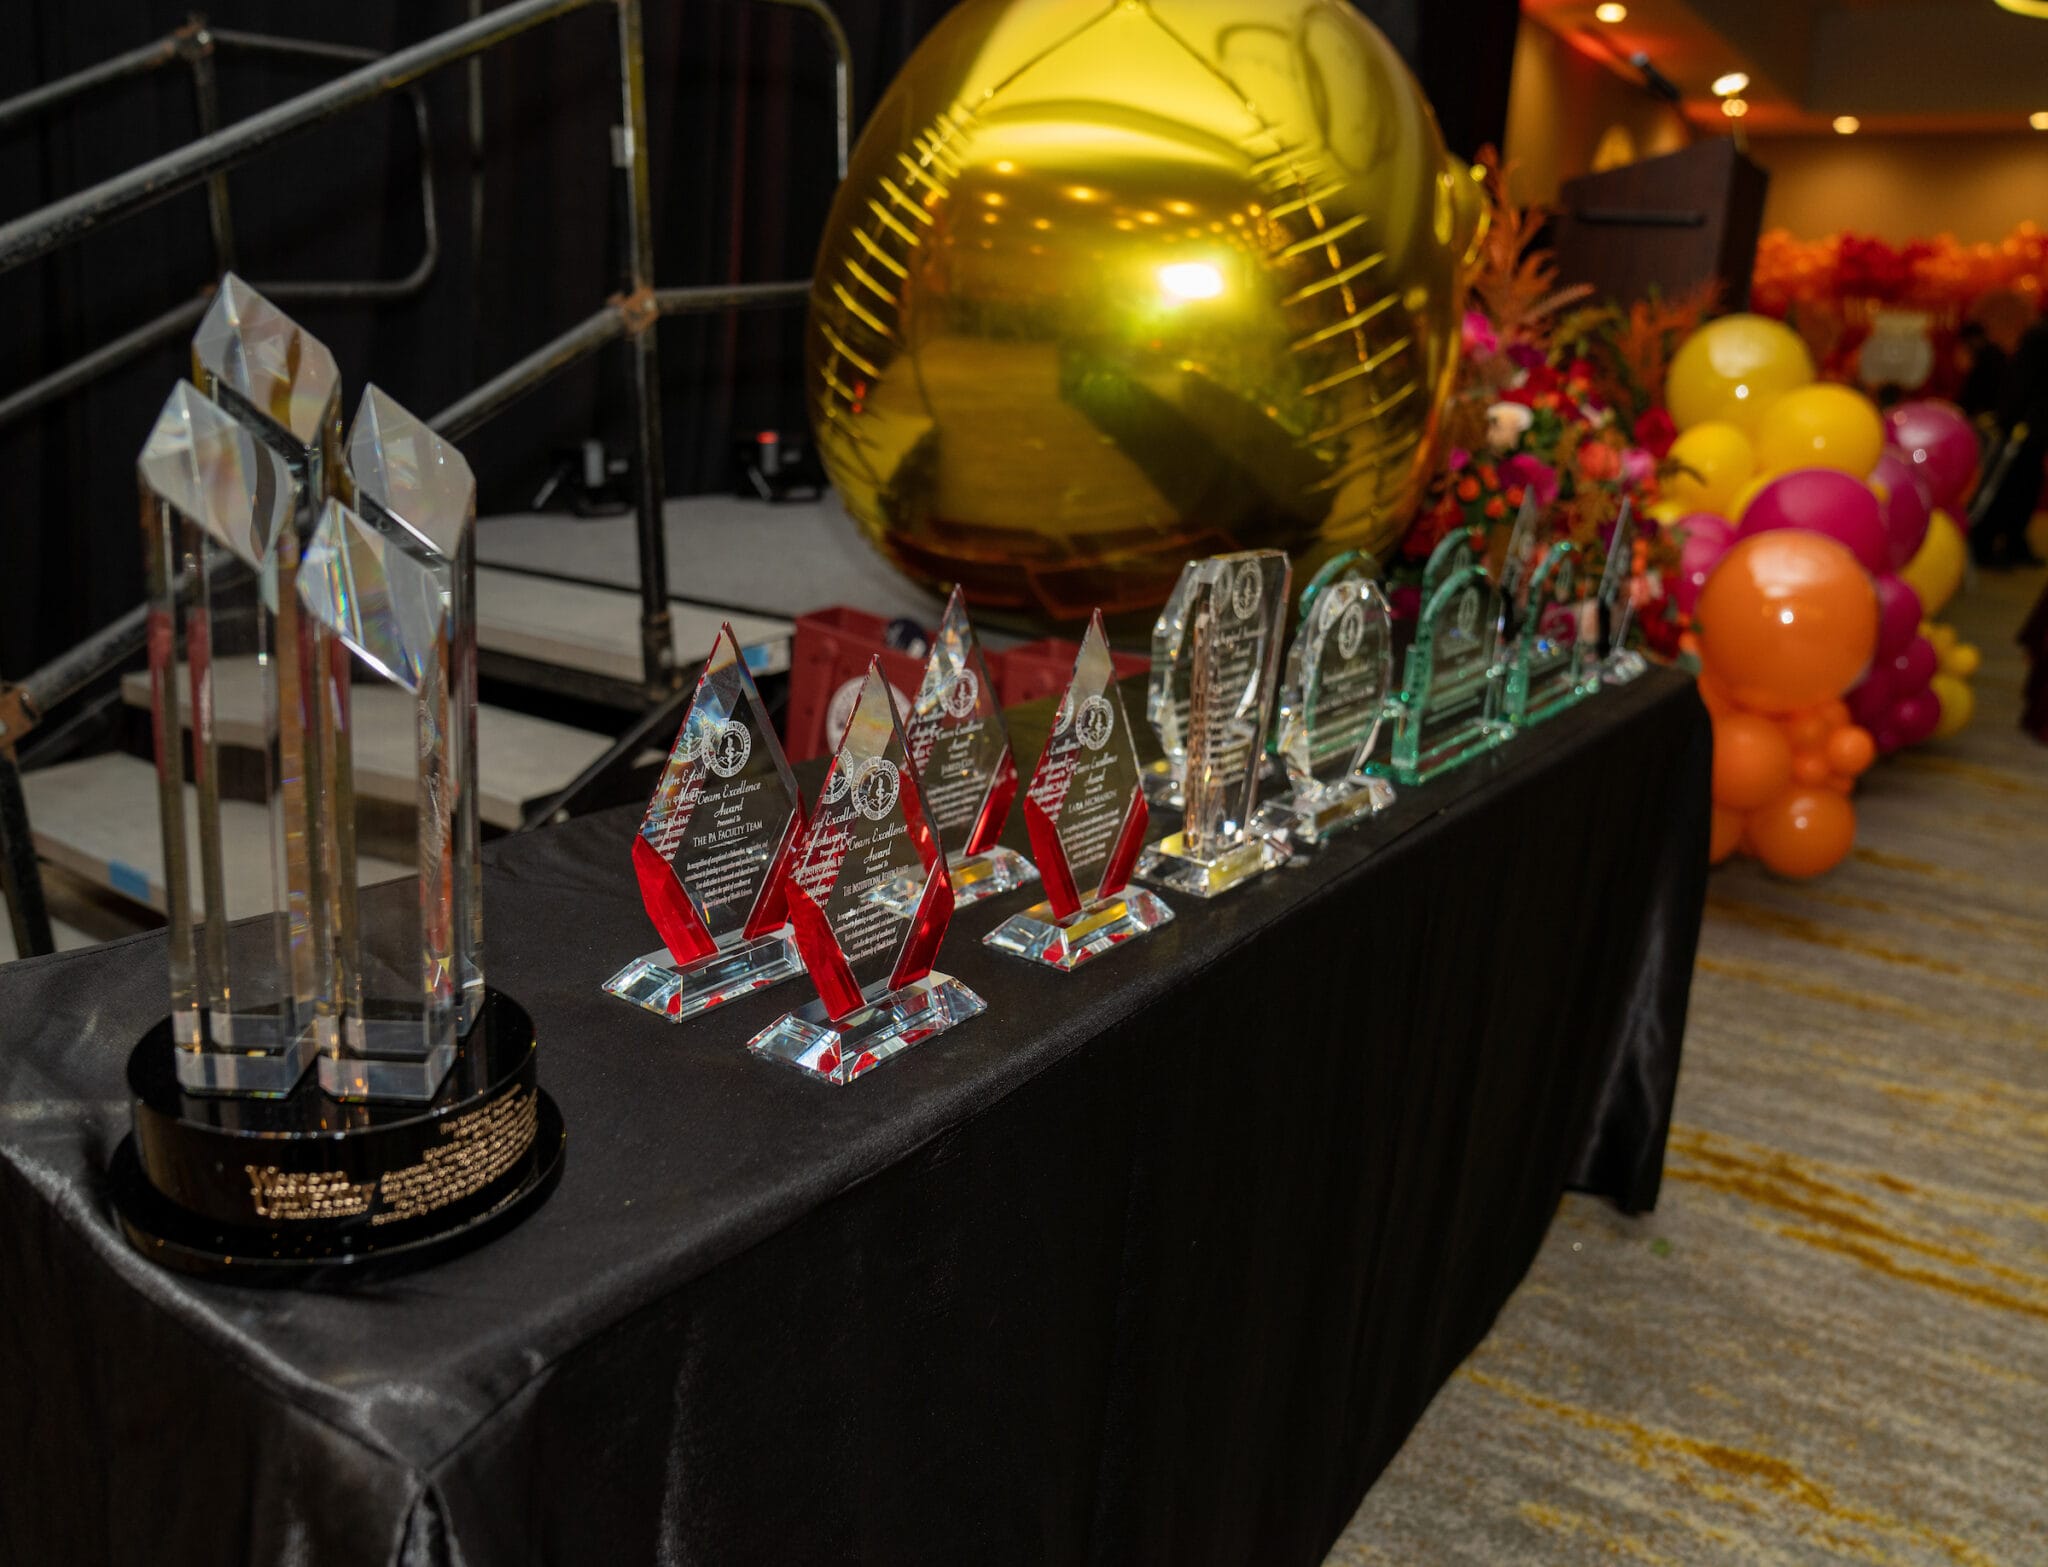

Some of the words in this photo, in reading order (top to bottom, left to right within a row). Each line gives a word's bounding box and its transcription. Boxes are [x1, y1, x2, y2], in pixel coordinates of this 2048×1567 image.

[697, 790, 721, 805] Team
[722, 779, 761, 798] Excellence
[713, 797, 745, 818] Award
[693, 836, 707, 848] THE
[718, 825, 745, 841] FACULTY
[746, 819, 763, 833] TEAM
[848, 835, 870, 851] Team
[872, 822, 908, 843] Excellence
[863, 840, 893, 864] Award
